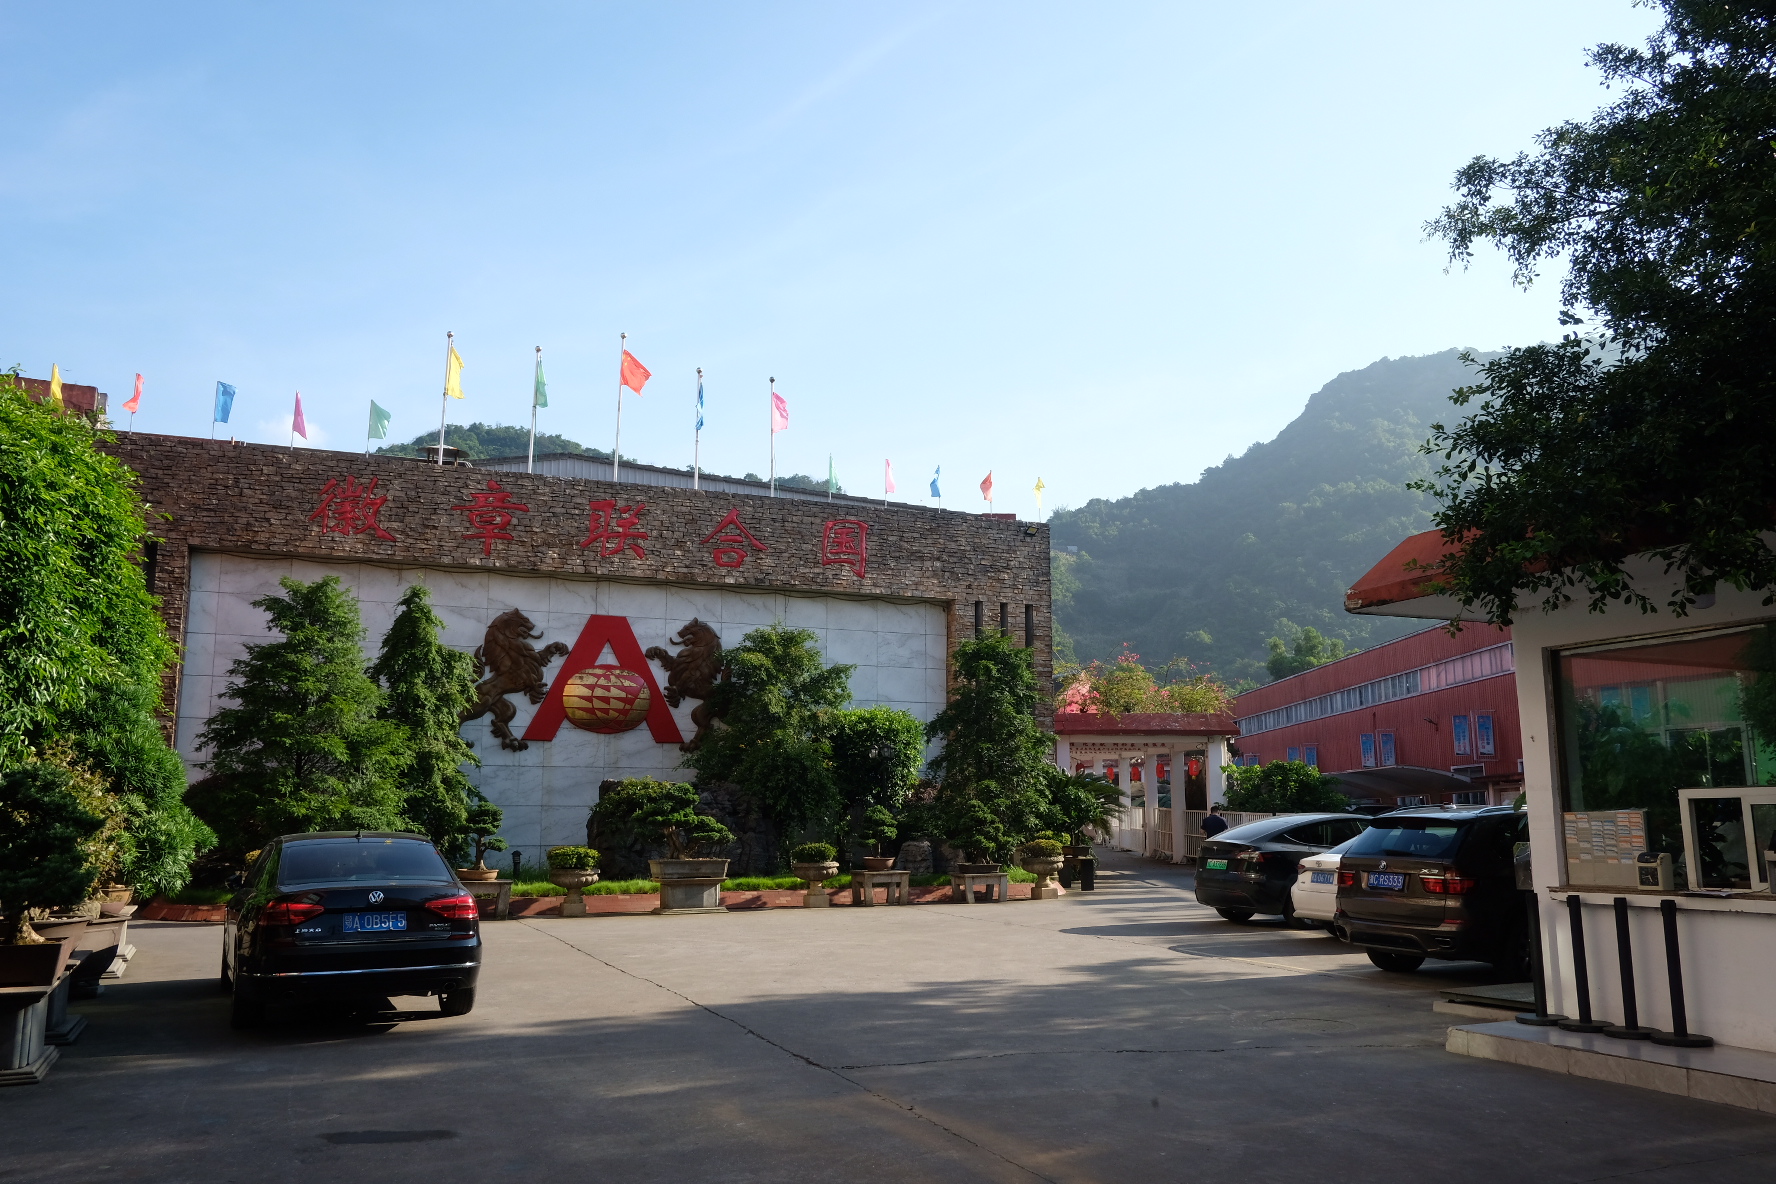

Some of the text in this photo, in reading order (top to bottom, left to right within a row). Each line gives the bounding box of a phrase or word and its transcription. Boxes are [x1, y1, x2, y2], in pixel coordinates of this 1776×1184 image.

[308, 474, 870, 580] 徽章联合国
